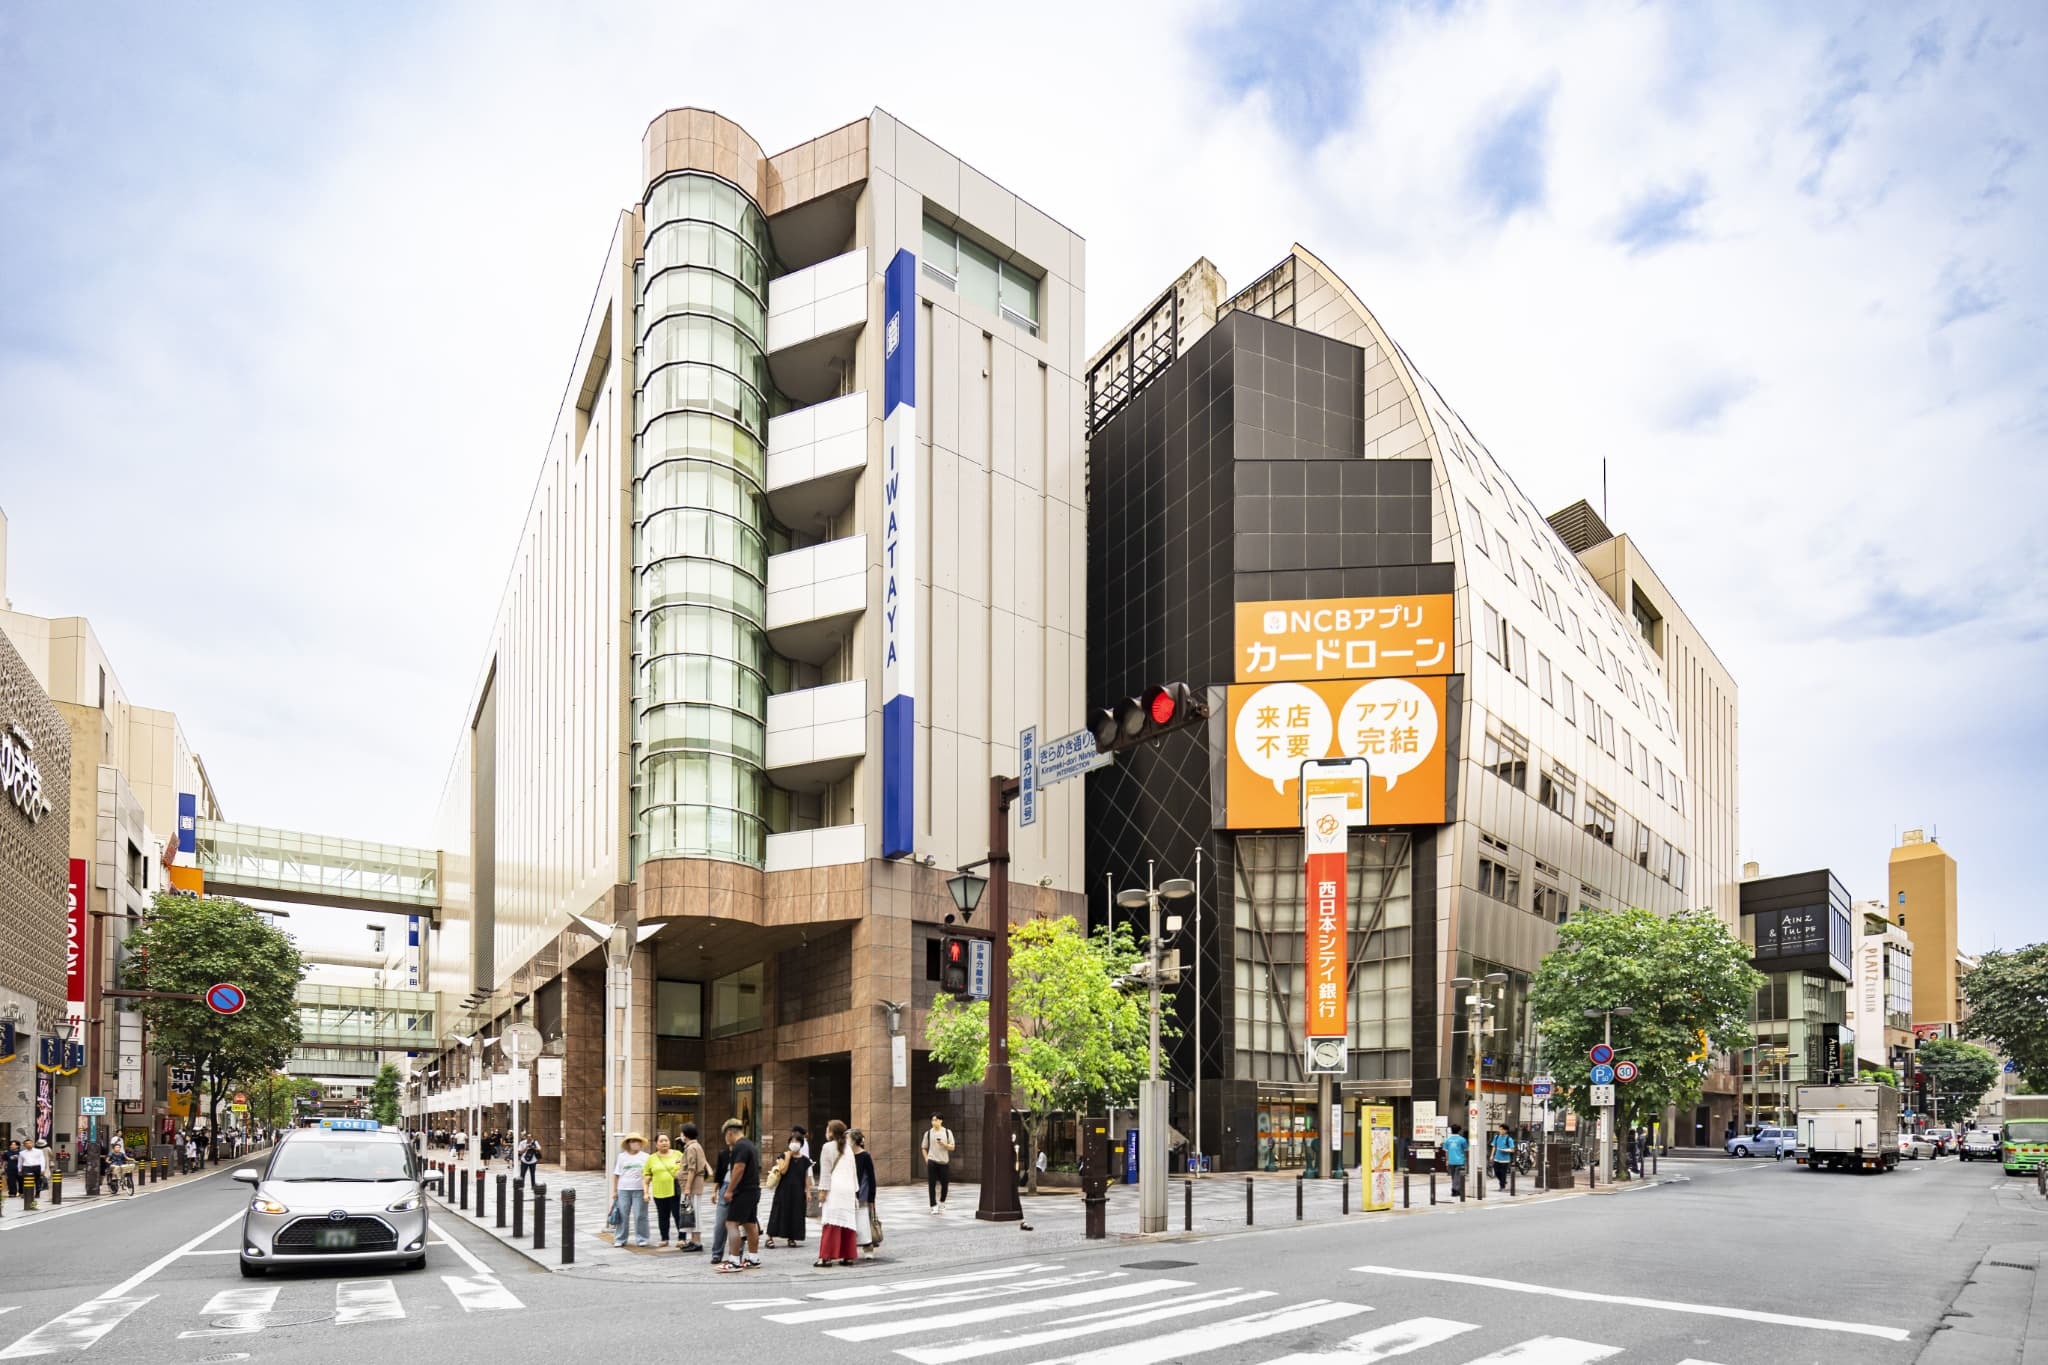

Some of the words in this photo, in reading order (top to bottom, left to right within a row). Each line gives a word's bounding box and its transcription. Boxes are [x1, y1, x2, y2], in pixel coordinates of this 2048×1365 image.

[885, 445, 899, 668] IWATAYA
[1290, 604, 1423, 632] NCBアプリ
[1245, 638, 1445, 673] カードローン
[1256, 704, 1311, 729] 来店
[1356, 698, 1420, 722] アプリ
[1256, 734, 1311, 759] 不要
[1357, 726, 1420, 755] 完結
[1023, 732, 1033, 821] 歩車分離信号
[1056, 761, 1090, 777] INTERSECTION
[1318, 881, 1337, 1018] 西日本シティ銀行
[1595, 1068, 1605, 1082] P
[1619, 1067, 1632, 1077] 30
